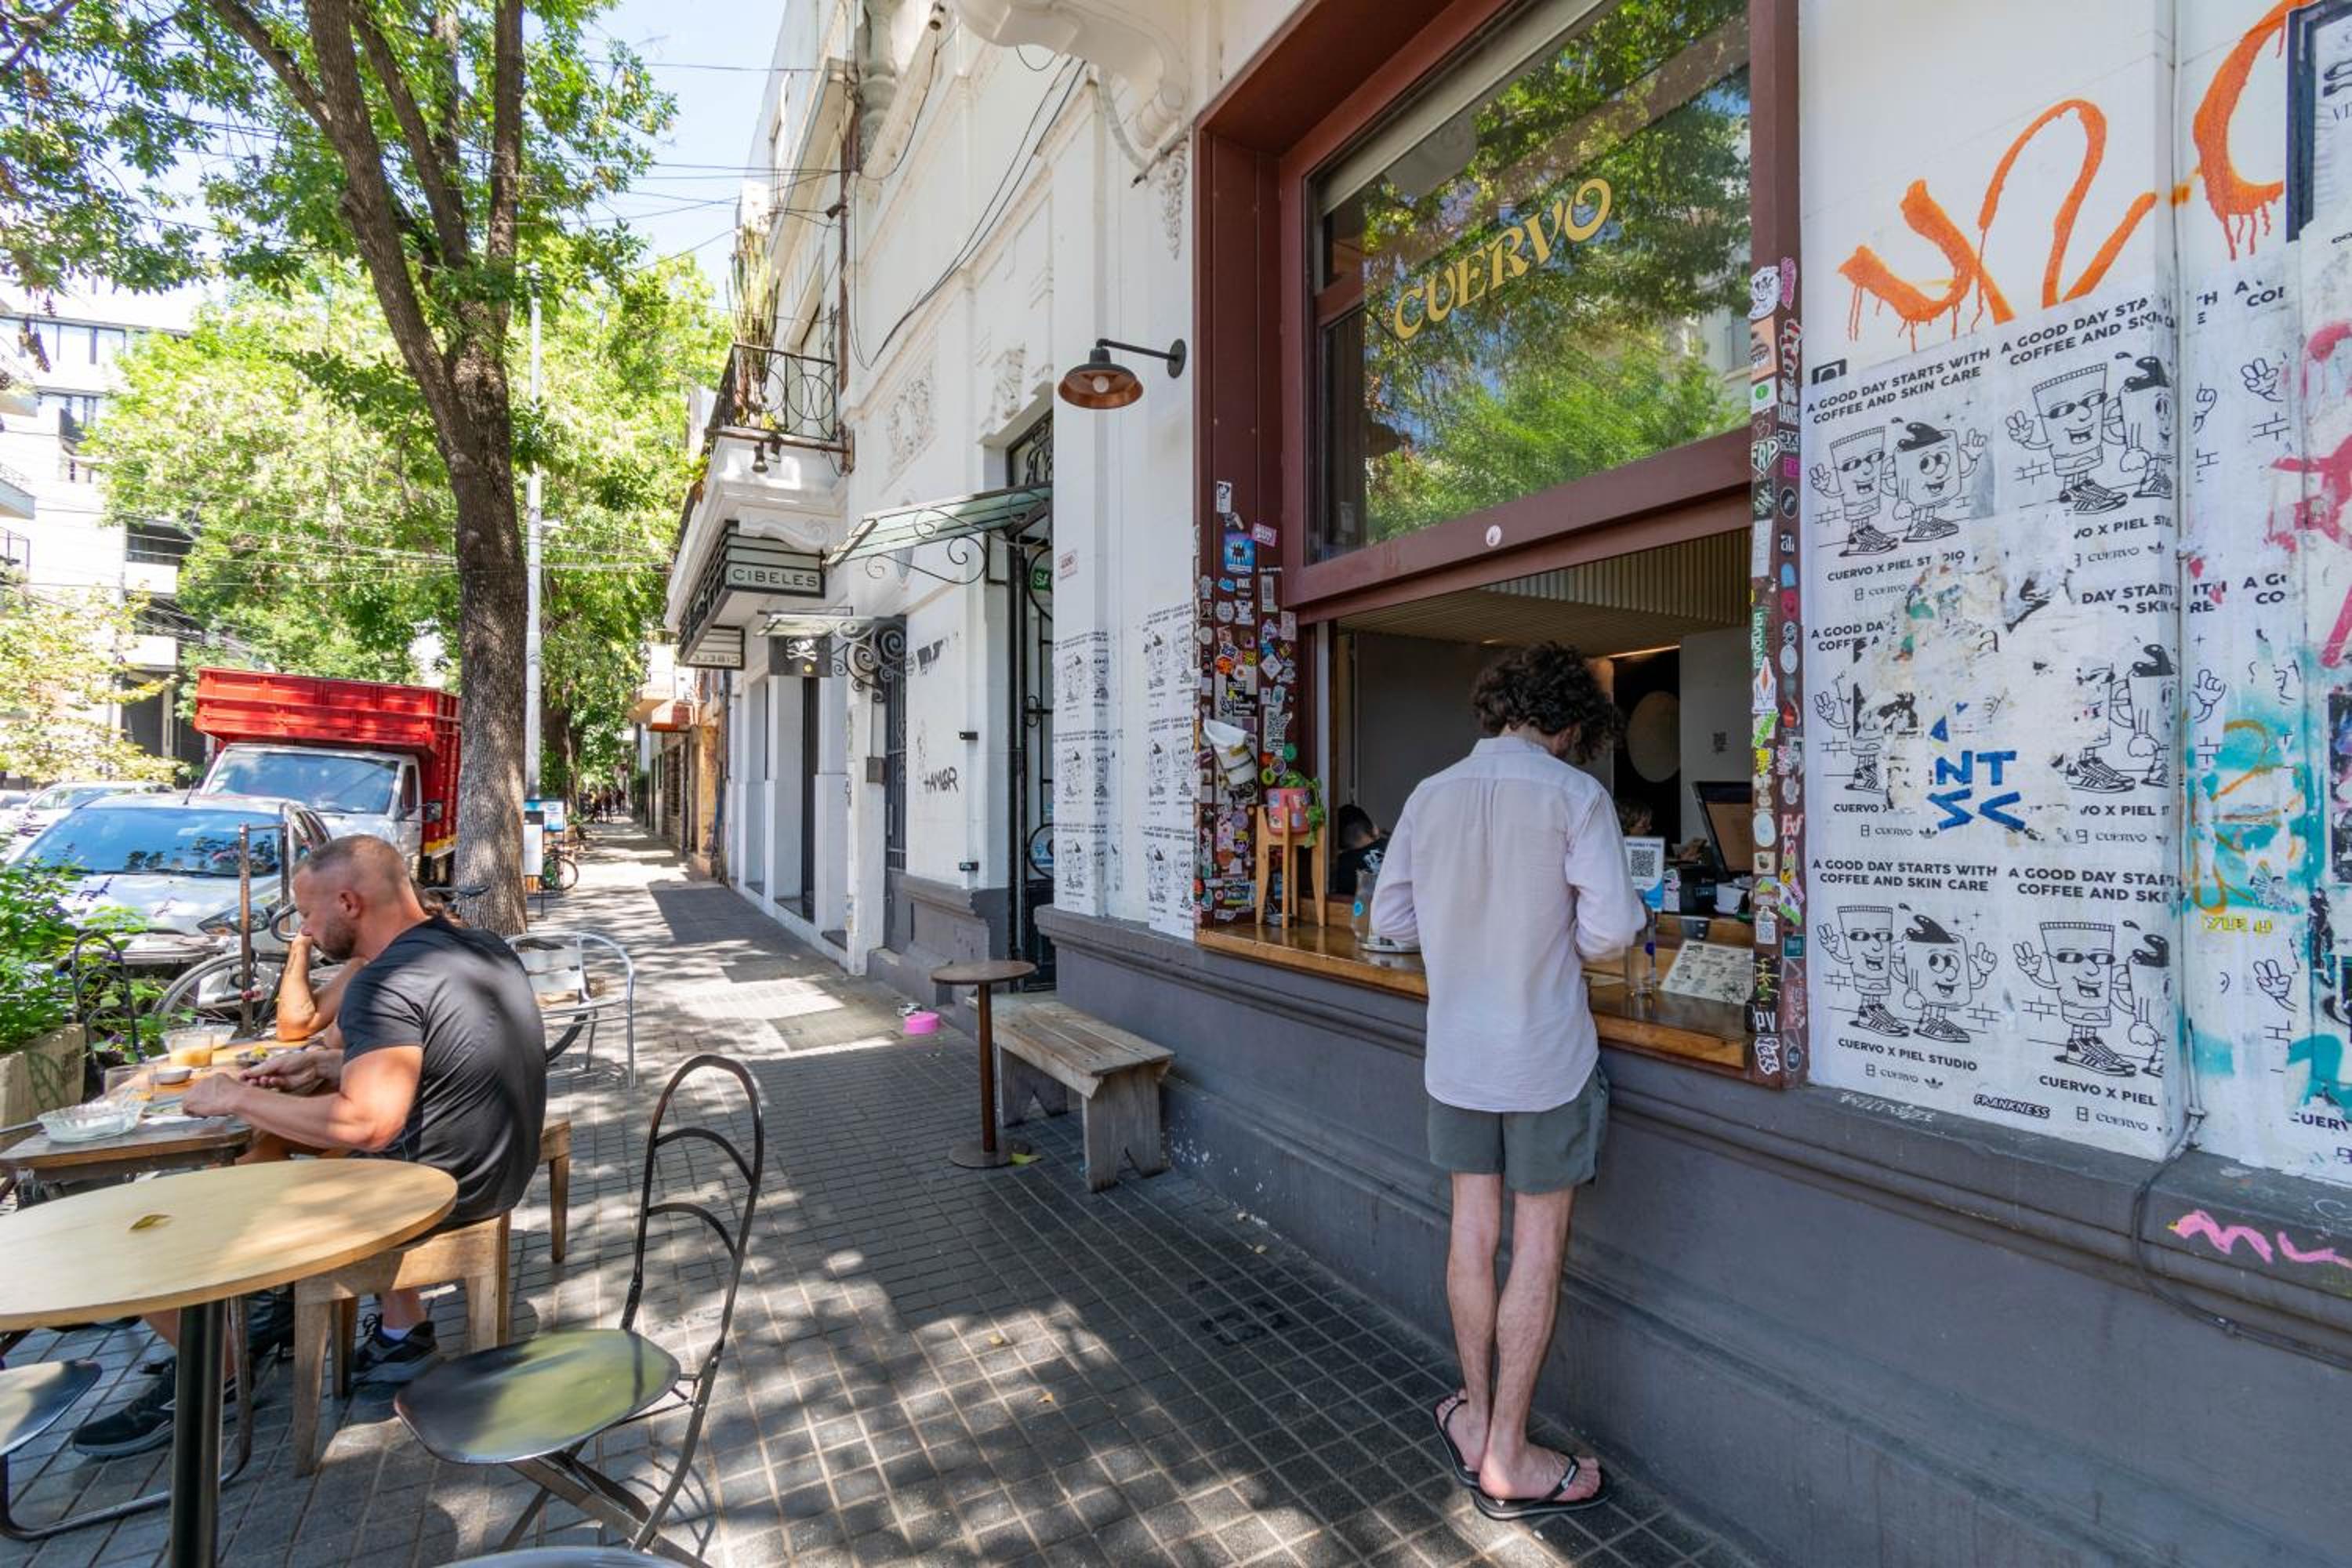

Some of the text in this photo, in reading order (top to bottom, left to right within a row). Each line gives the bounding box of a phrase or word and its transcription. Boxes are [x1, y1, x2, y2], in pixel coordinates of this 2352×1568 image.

[1394, 177, 1612, 339] CUERVO
[2001, 342, 2012, 354] A
[2017, 323, 2068, 347] GOOD
[2074, 309, 2109, 331] DAY
[2009, 336, 2076, 365] COFFEE
[2082, 323, 2122, 344] AND
[1806, 348, 1991, 413] A GOOD DAY STARTS WITH
[1813, 401, 1863, 424] COFFEE
[1867, 390, 1896, 409] AND
[1900, 380, 1934, 400] SKIN
[1940, 366, 1981, 387] CARE
[2098, 524, 2108, 535] X
[2113, 517, 2149, 532] PIEL
[732, 568, 818, 588] CIBELES
[1828, 566, 1874, 581] CUERVO
[1876, 563, 1885, 573] X
[1887, 559, 1914, 571] PIEL
[2082, 588, 2117, 604] DAY
[2243, 576, 2258, 590] A
[1811, 629, 1820, 639] A
[1824, 624, 1863, 637] GOOD
[1833, 803, 1879, 813] CUERVO
[2105, 805, 2116, 816] X
[2121, 805, 2157, 816] PIEL
[1813, 858, 1998, 877] A GOOD DAY STARTS WITH
[2008, 867, 2020, 878] A
[2024, 868, 2076, 880] GOOD
[2082, 870, 2116, 883] DAY
[1820, 873, 1989, 891] COFFEE AND SKIN CARE
[2017, 883, 2084, 898] COFFEE
[2089, 888, 2129, 900] AND
[1838, 1037, 1978, 1072] CUERVO X PIEL STUDIO
[2038, 1075, 2158, 1106] CUERVO X PIEL
[1973, 1094, 2051, 1120] FRANKNESS
